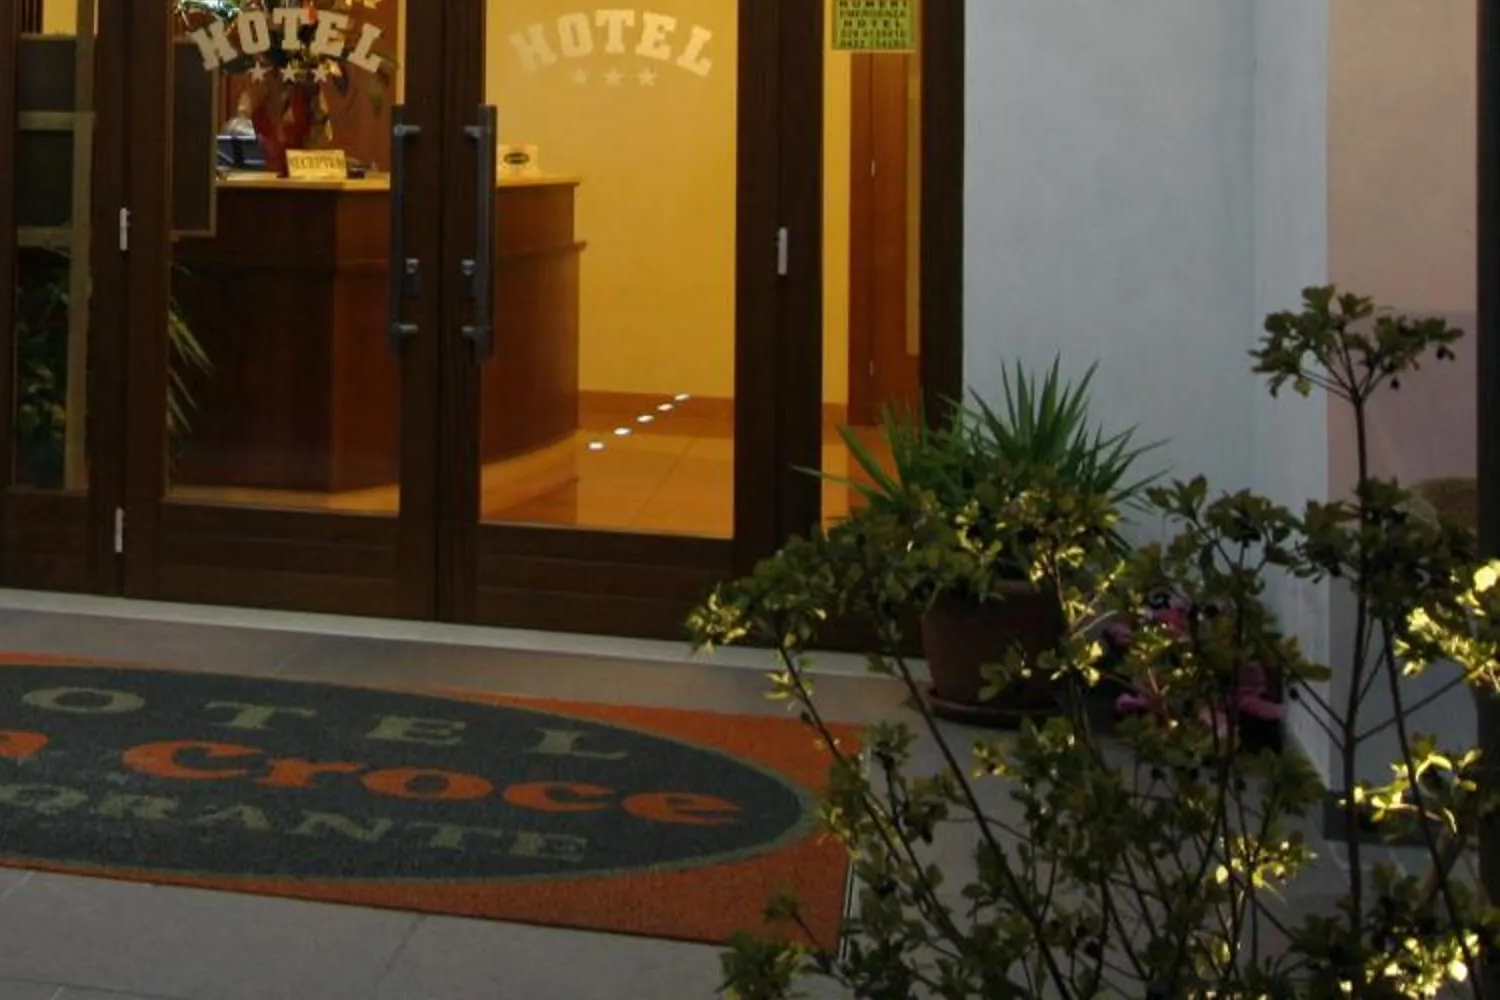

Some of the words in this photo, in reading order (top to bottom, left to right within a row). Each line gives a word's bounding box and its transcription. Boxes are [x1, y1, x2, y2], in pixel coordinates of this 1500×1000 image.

[188, 7, 384, 74] HOTEL
[510, 8, 713, 77] HOTEL
[120, 740, 742, 824] Croce
